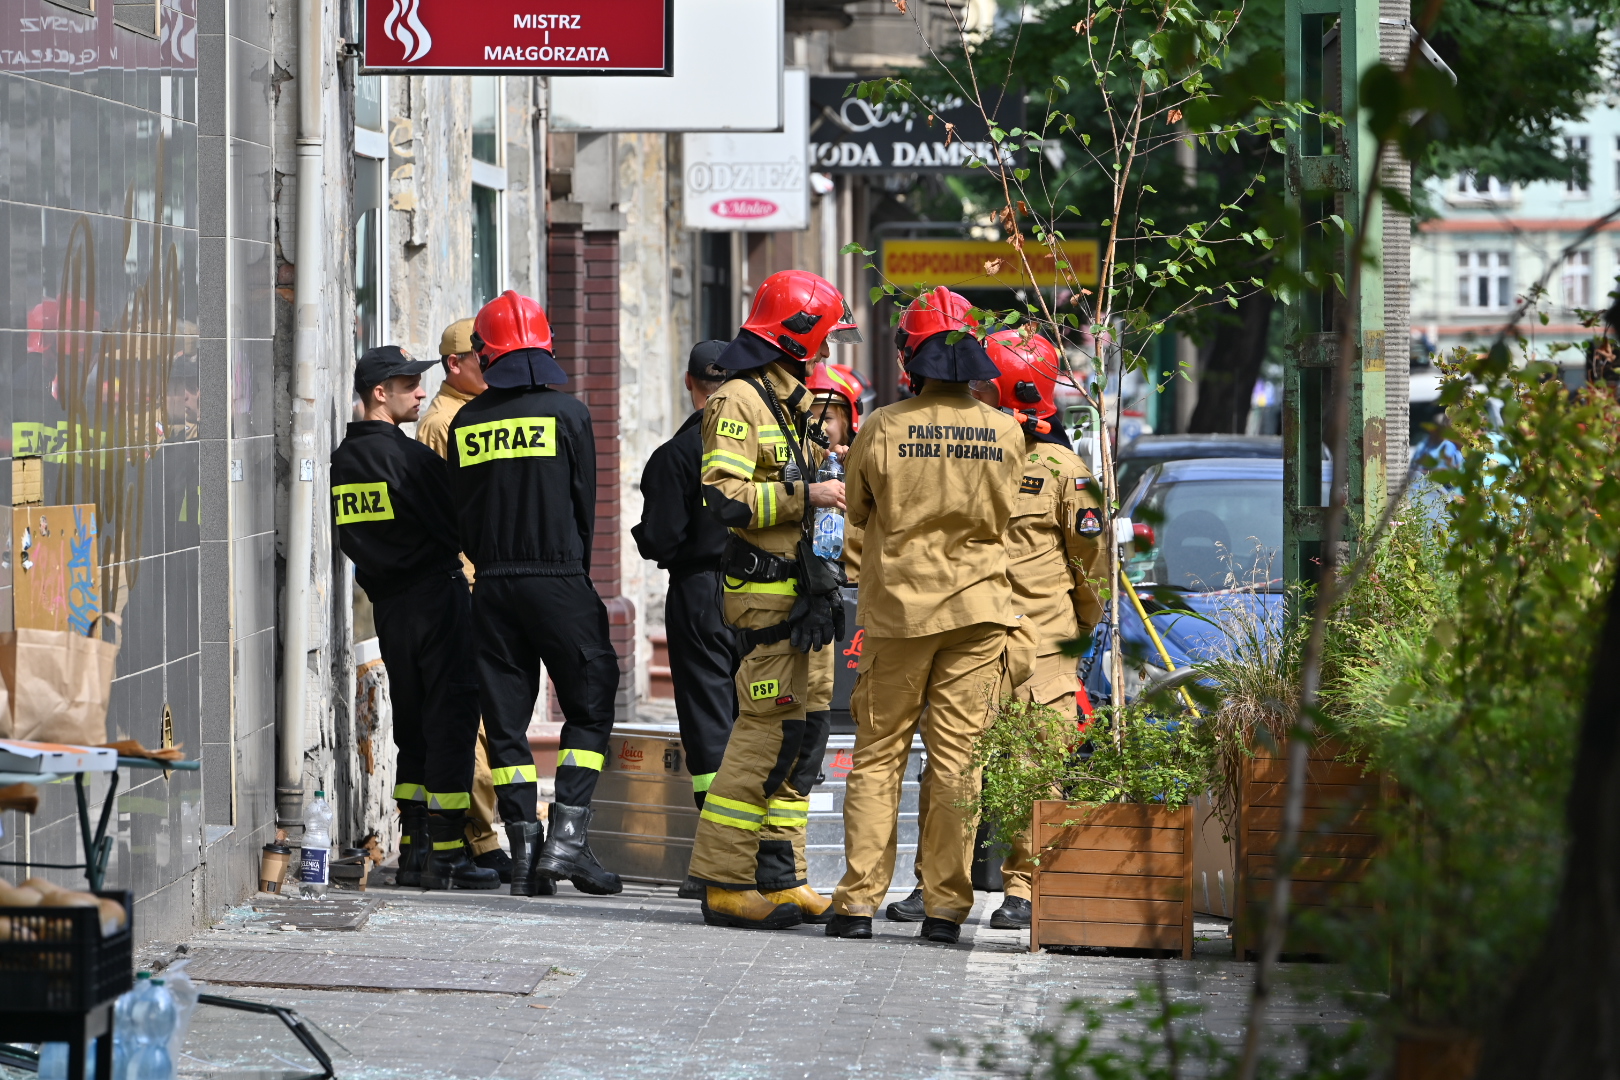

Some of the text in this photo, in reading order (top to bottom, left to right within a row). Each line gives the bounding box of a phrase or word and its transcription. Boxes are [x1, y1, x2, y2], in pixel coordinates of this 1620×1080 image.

[513, 14, 581, 29] MISTRZ
[544, 30, 549, 45] I
[484, 45, 610, 62] MAŁGORZATA
[892, 141, 1016, 166] DAMSKA
[687, 156, 803, 193] ODZIEŻ
[720, 421, 744, 436] PSP
[908, 423, 997, 442] PAŃSTWOWA
[752, 682, 775, 697] PSP
[618, 740, 644, 762] Leica
[829, 749, 854, 770] Lei
